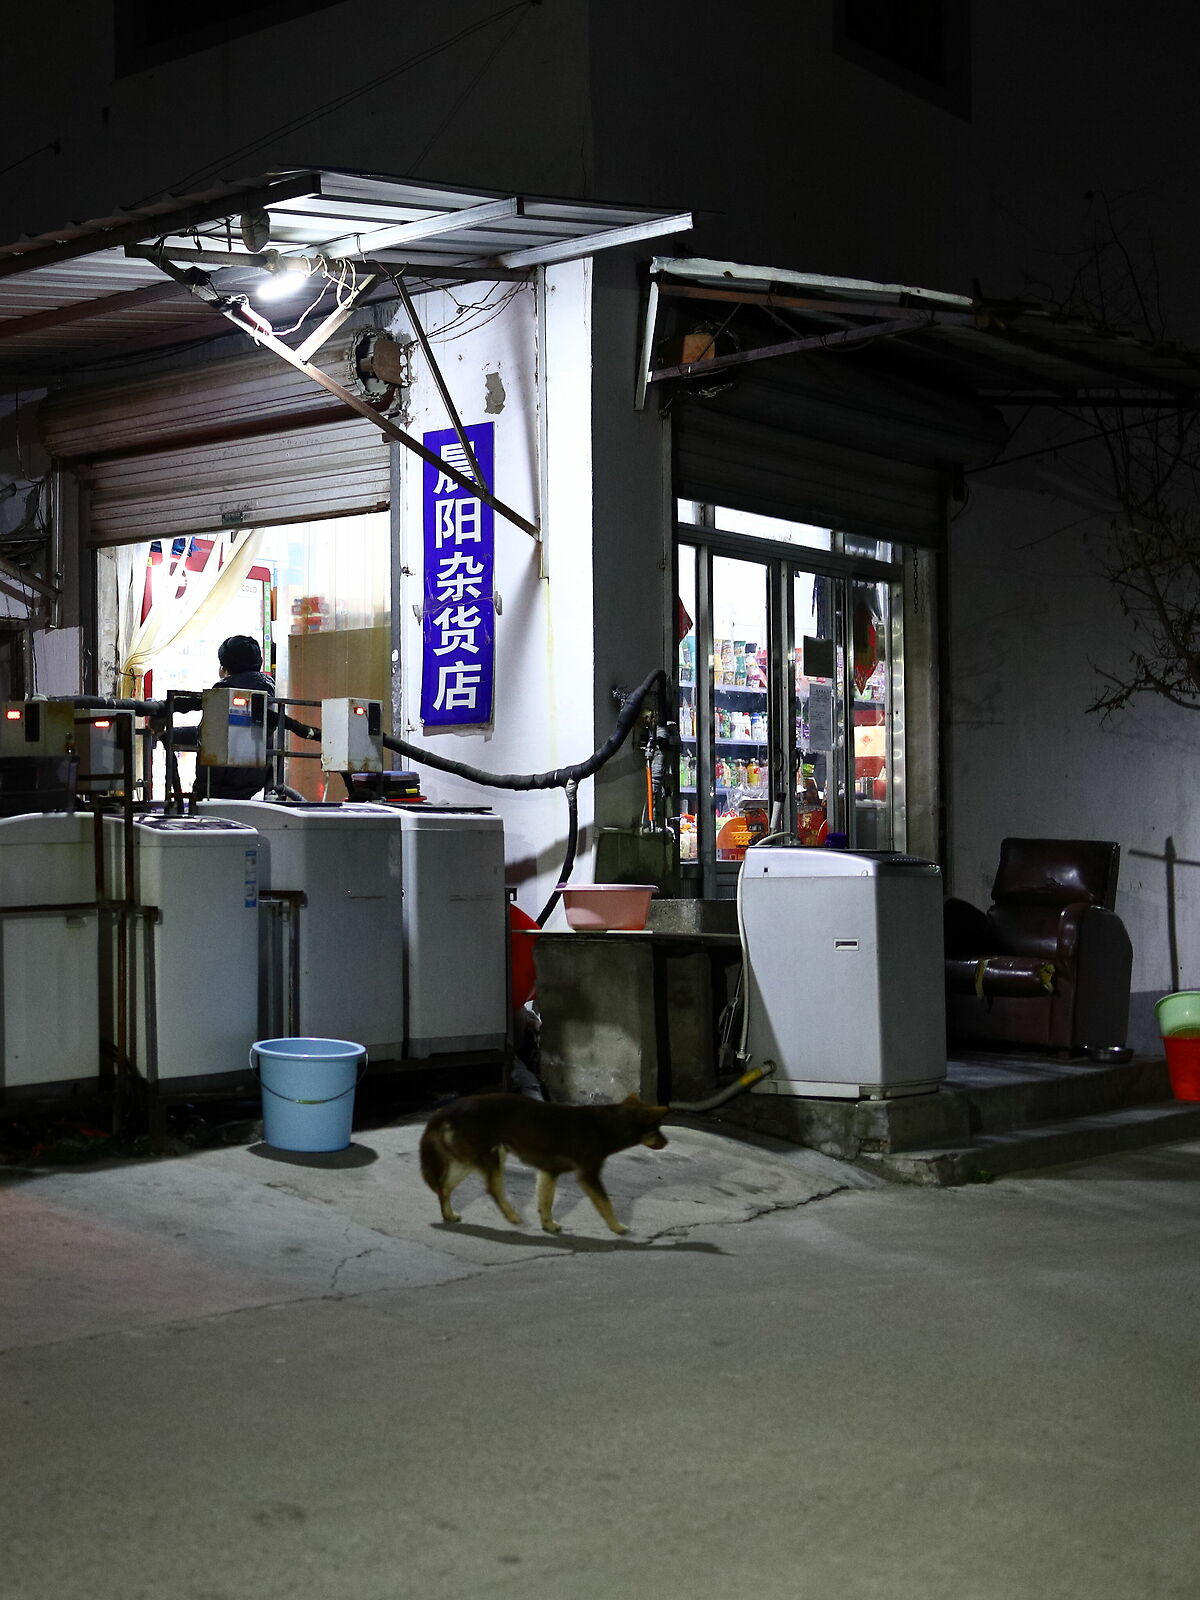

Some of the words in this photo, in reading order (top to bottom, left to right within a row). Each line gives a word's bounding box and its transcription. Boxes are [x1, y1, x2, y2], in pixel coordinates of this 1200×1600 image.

[432, 440, 484, 710] 晨阳杂货店
